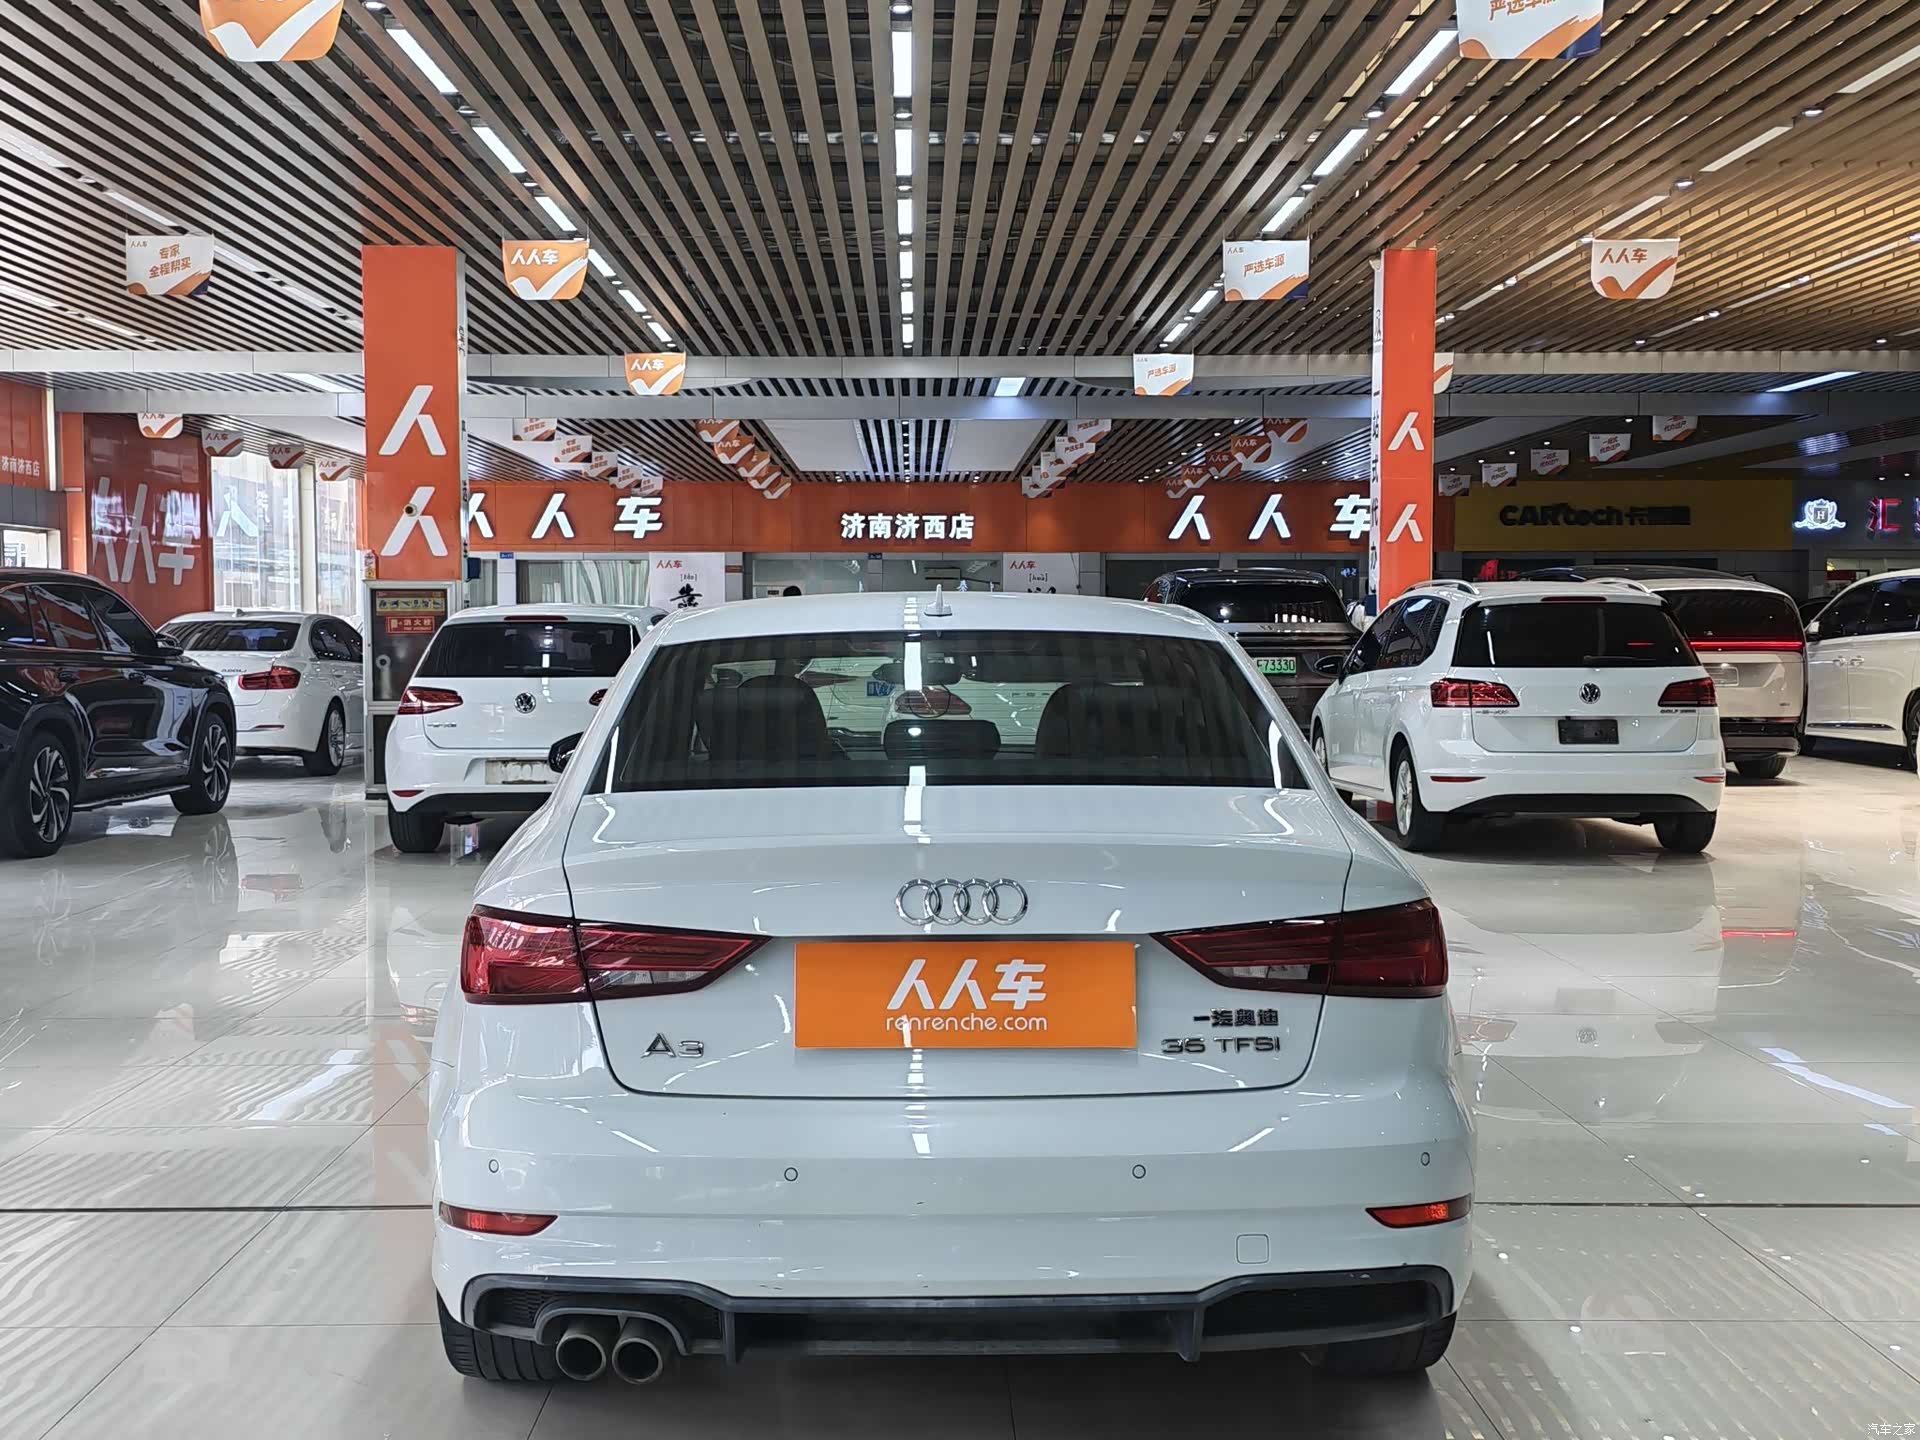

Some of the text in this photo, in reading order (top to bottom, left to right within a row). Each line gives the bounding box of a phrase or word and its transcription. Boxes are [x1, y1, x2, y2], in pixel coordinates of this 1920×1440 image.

[159, 243, 180, 259] 专家
[511, 248, 559, 265] 人人车
[1600, 247, 1648, 264] 人人车
[149, 256, 191, 279] 全程帮买
[1243, 253, 1285, 277] 严选车源
[631, 358, 665, 371] 人人车
[205, 431, 229, 441] 人人车
[1235, 438, 1257, 448] 人人车
[271, 446, 291, 455] 人人车
[319, 460, 337, 469] 人人车
[1168, 493, 1371, 540] 人人车
[840, 512, 975, 540] 济南济西店
[656, 559, 683, 569] 人人车
[1009, 560, 1036, 569] 人人车
[886, 958, 1047, 1011] 人人车
[886, 1012, 1048, 1032] renrenche.com
[1193, 1008, 1279, 1027] 一汽奥迪
[640, 1032, 705, 1059] A3
[1161, 1036, 1281, 1054] 35 TFSI
